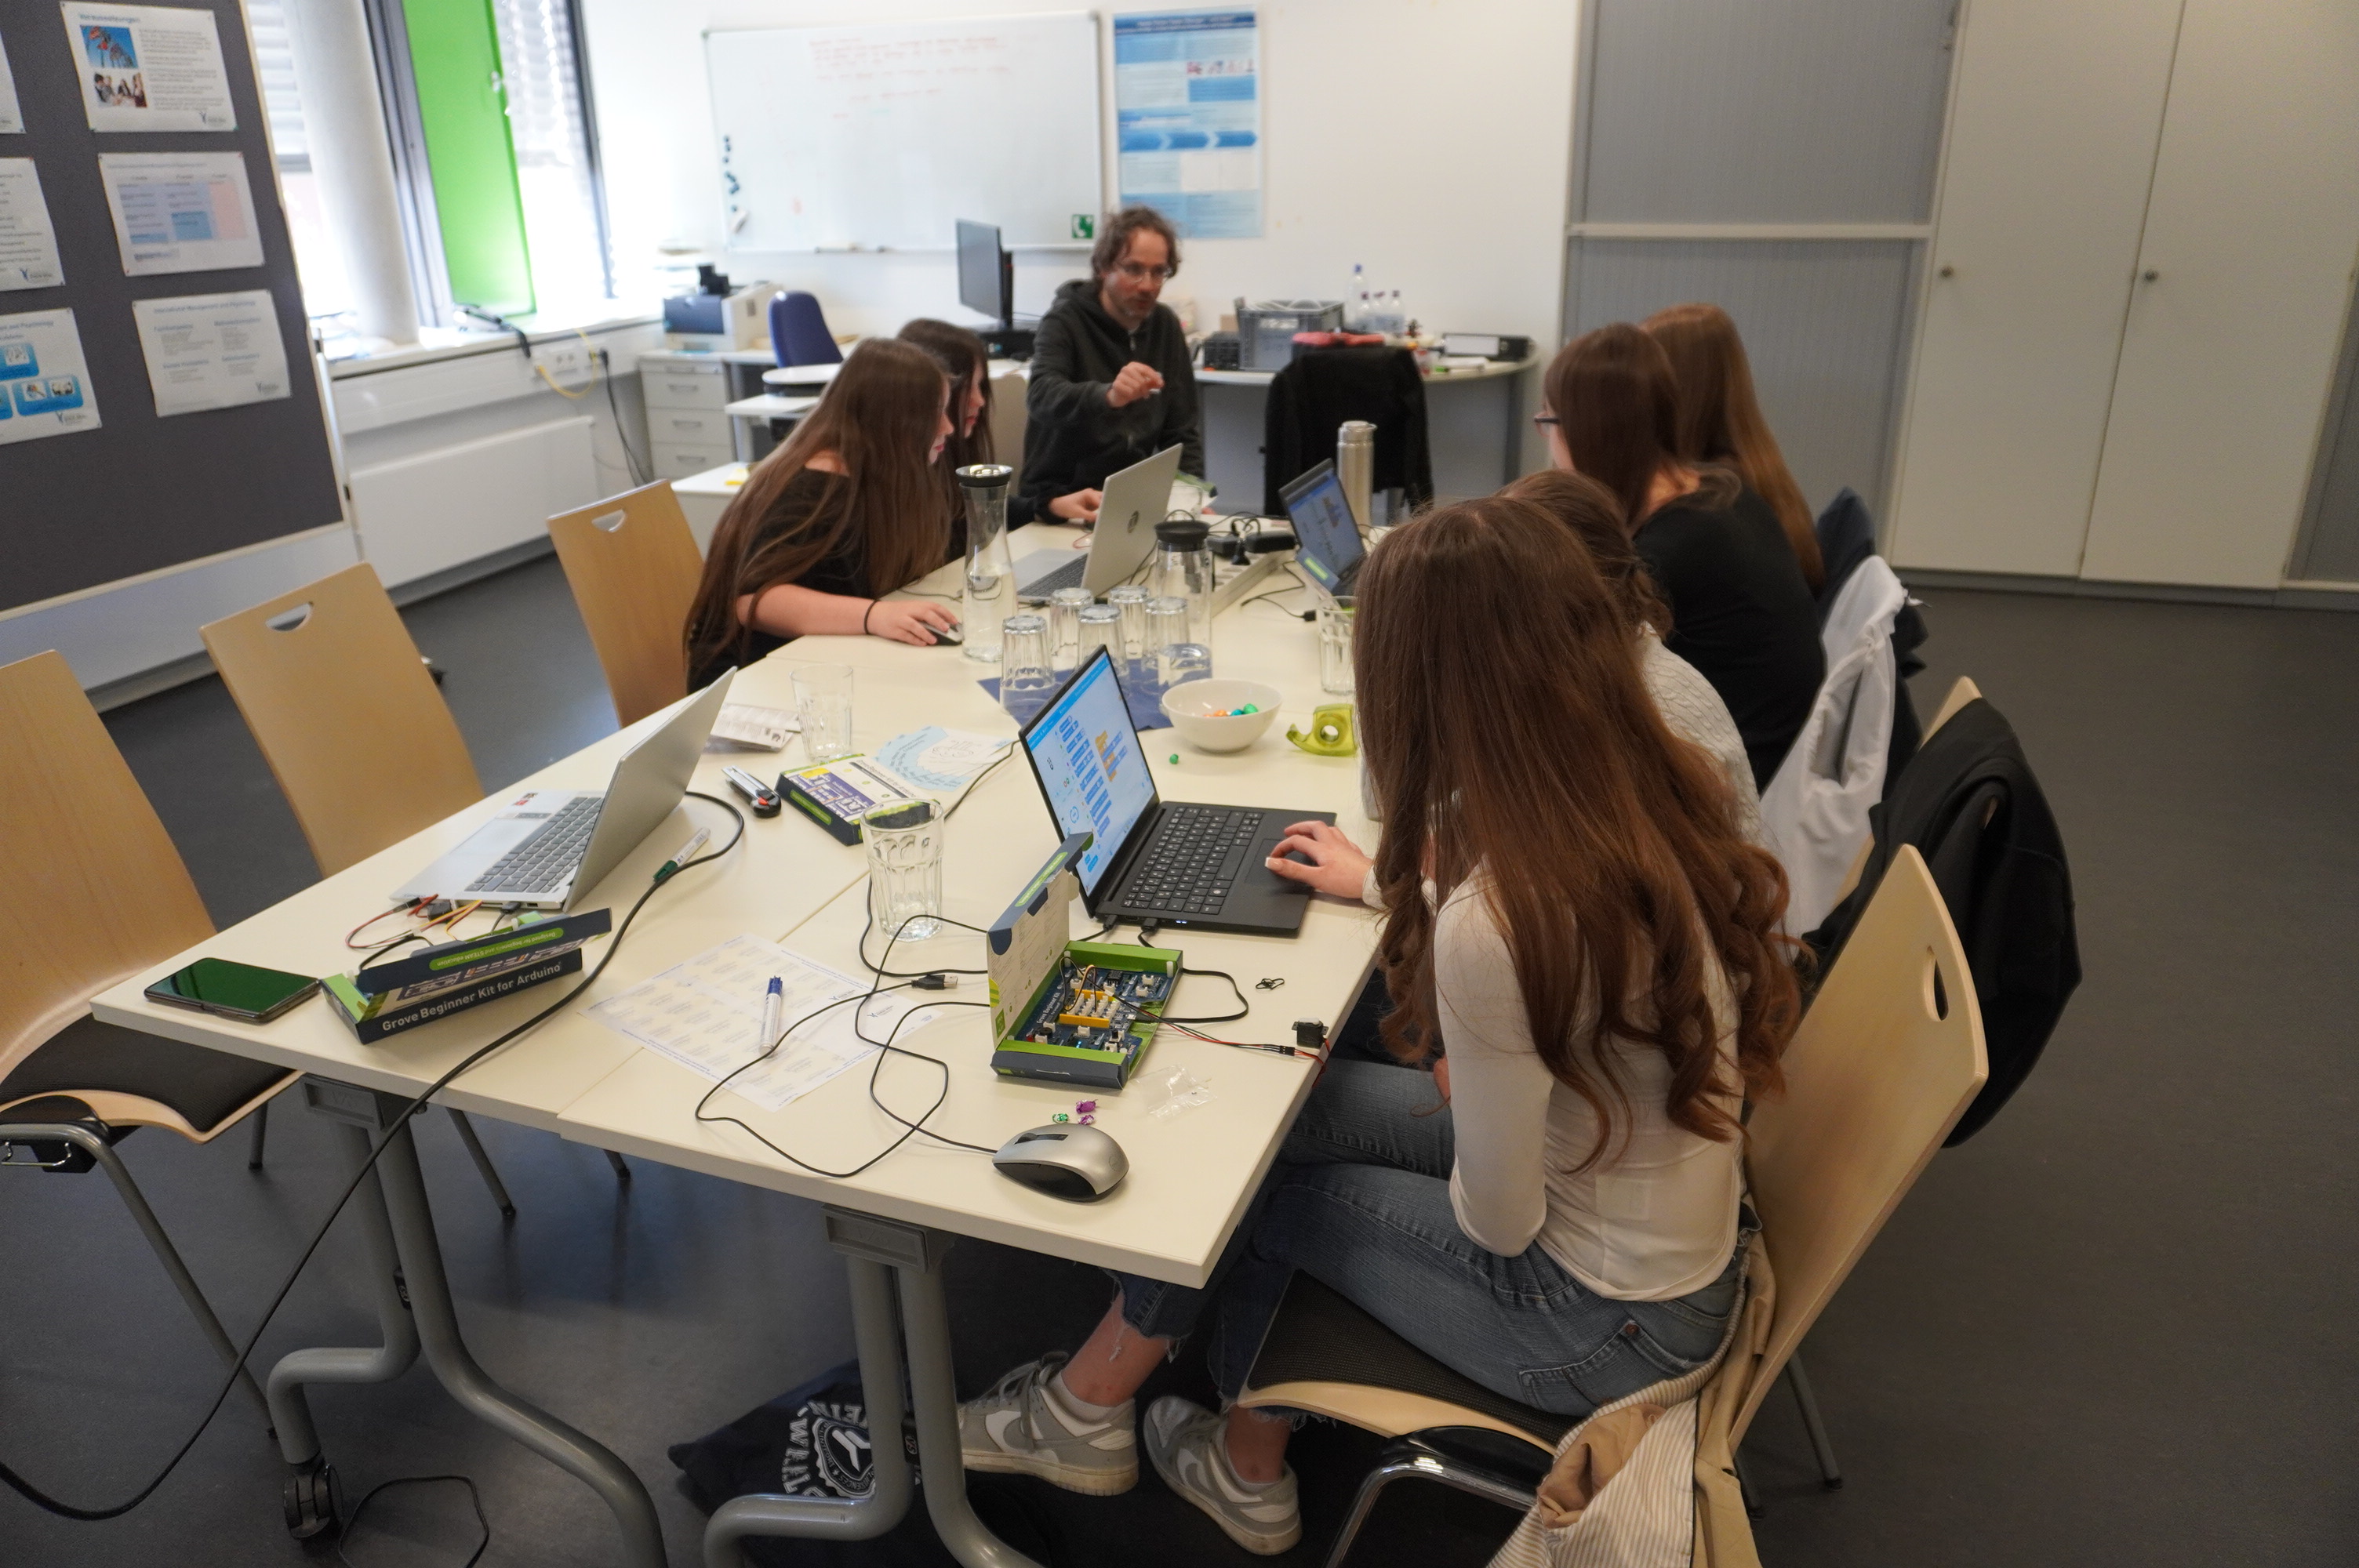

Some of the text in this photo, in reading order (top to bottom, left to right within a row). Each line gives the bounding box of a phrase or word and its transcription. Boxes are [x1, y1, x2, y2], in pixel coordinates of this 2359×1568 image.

[382, 965, 561, 1032] Grove Beginner Kit for Arduino
